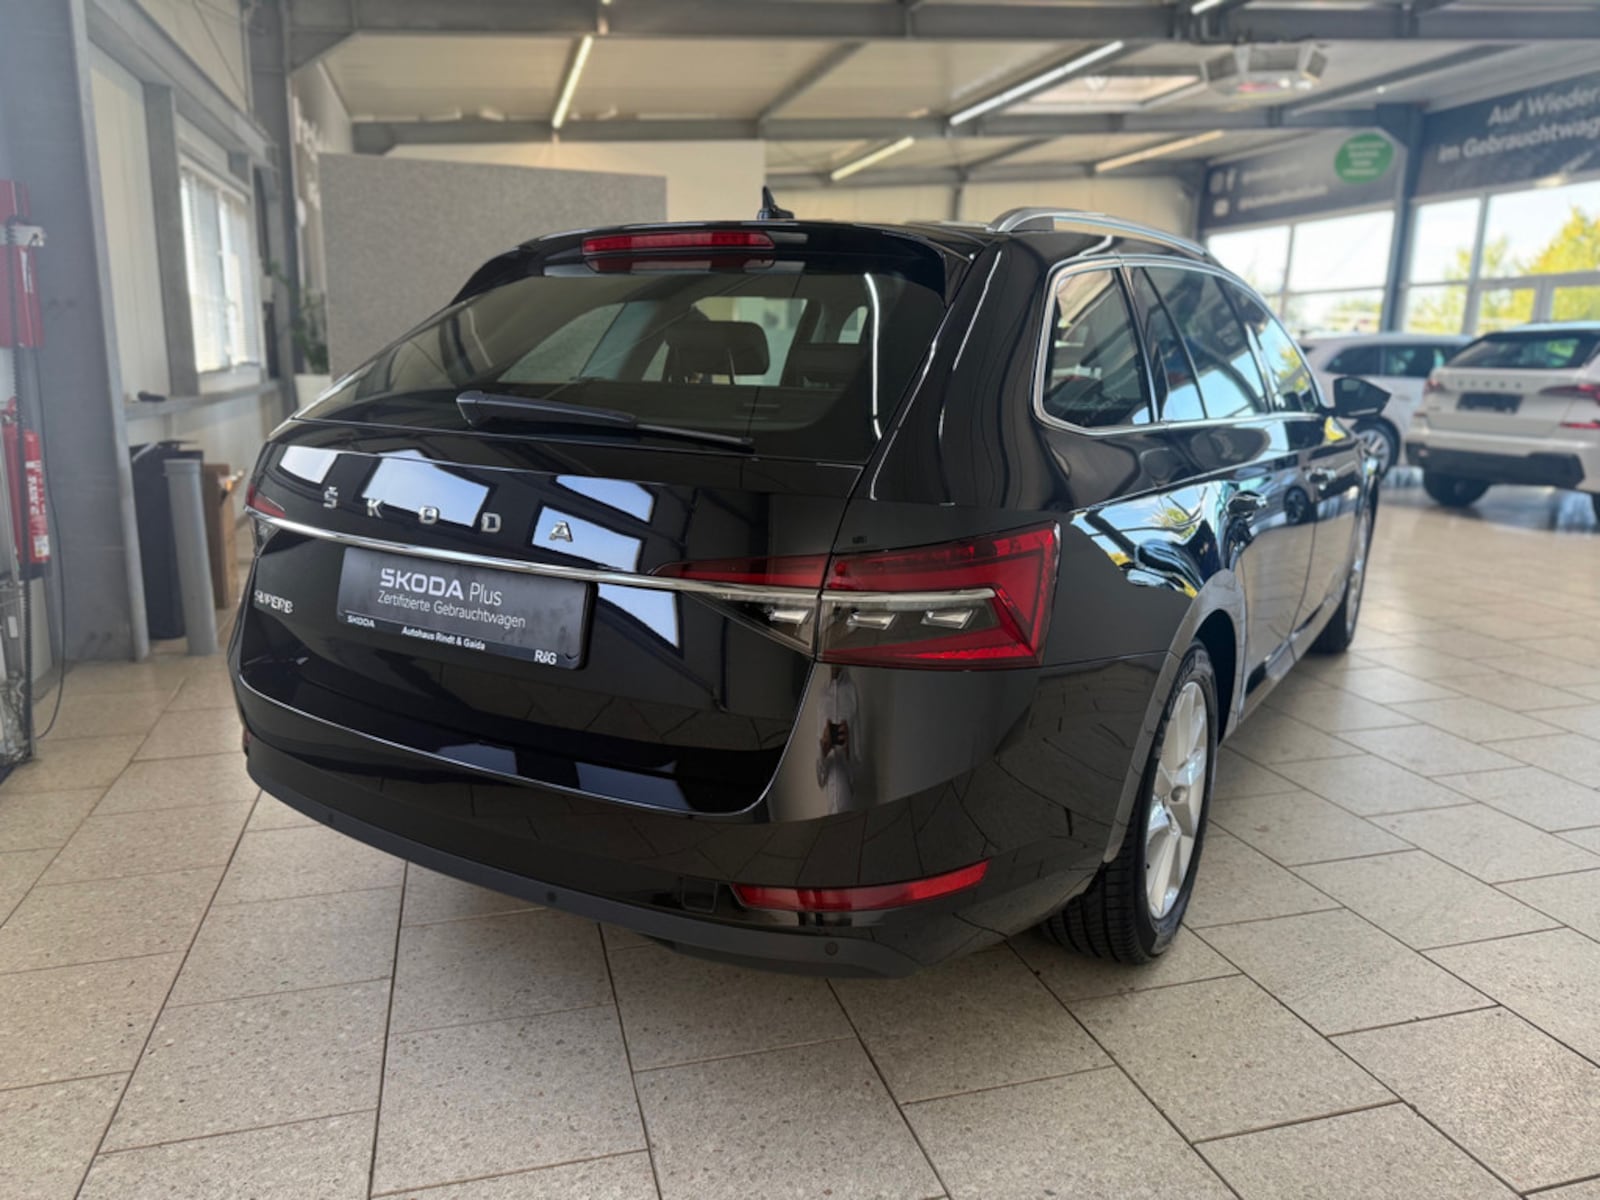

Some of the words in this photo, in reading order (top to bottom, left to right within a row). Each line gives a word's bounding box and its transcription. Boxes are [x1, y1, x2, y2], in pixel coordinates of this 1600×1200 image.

[1488, 99, 1522, 126] Auf
[380, 568, 464, 600] SKODA
[469, 582, 502, 606] Plus
[347, 615, 375, 628] SKODA
[378, 590, 431, 612] Zertifizierte
[433, 600, 526, 629] Gebrauchtwagen
[401, 626, 435, 641] Autohaus
[456, 637, 462, 646] &
[463, 638, 485, 650] Gaida
